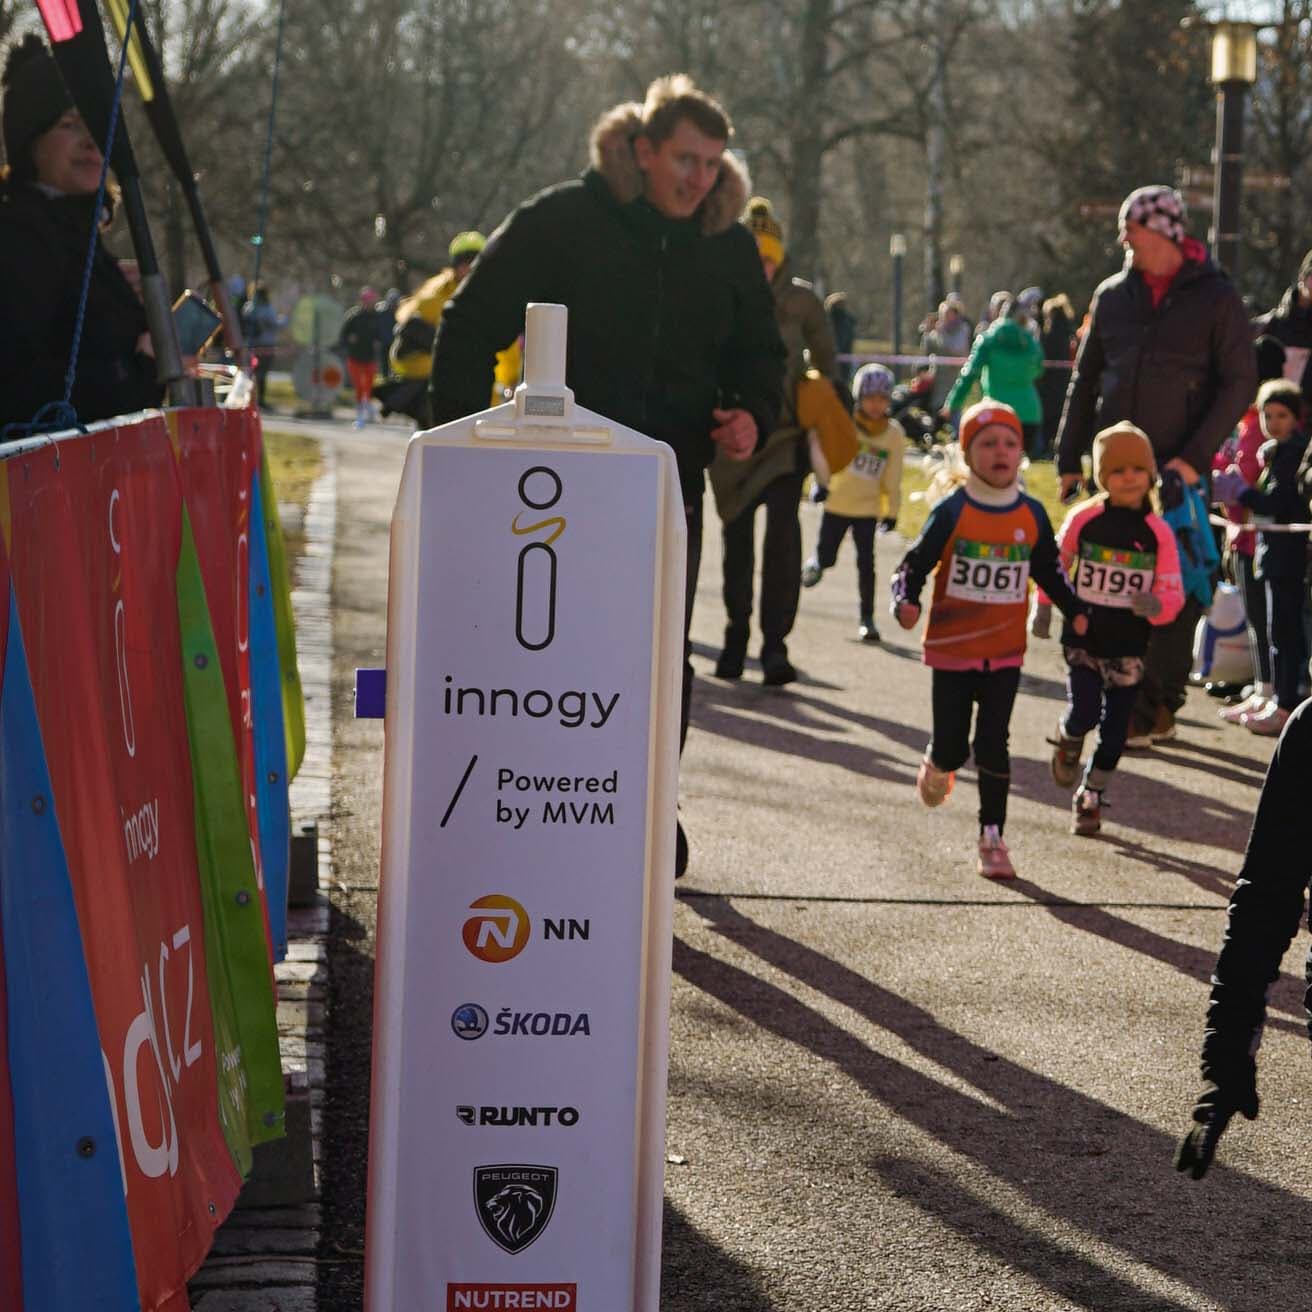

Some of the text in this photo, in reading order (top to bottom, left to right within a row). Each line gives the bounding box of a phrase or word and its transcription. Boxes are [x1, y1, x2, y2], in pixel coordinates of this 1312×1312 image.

[951, 558, 1022, 589] 3061
[1081, 564, 1144, 594] 3199
[443, 674, 621, 729] innogy
[497, 768, 618, 794] Powered
[496, 800, 615, 830] by MVM
[543, 917, 591, 941] NN
[493, 1007, 592, 1037] ŠKODA
[480, 1105, 581, 1128] RUNTO
[480, 1170, 551, 1183] PEUGEOT
[454, 1289, 572, 1310] NUTREND
